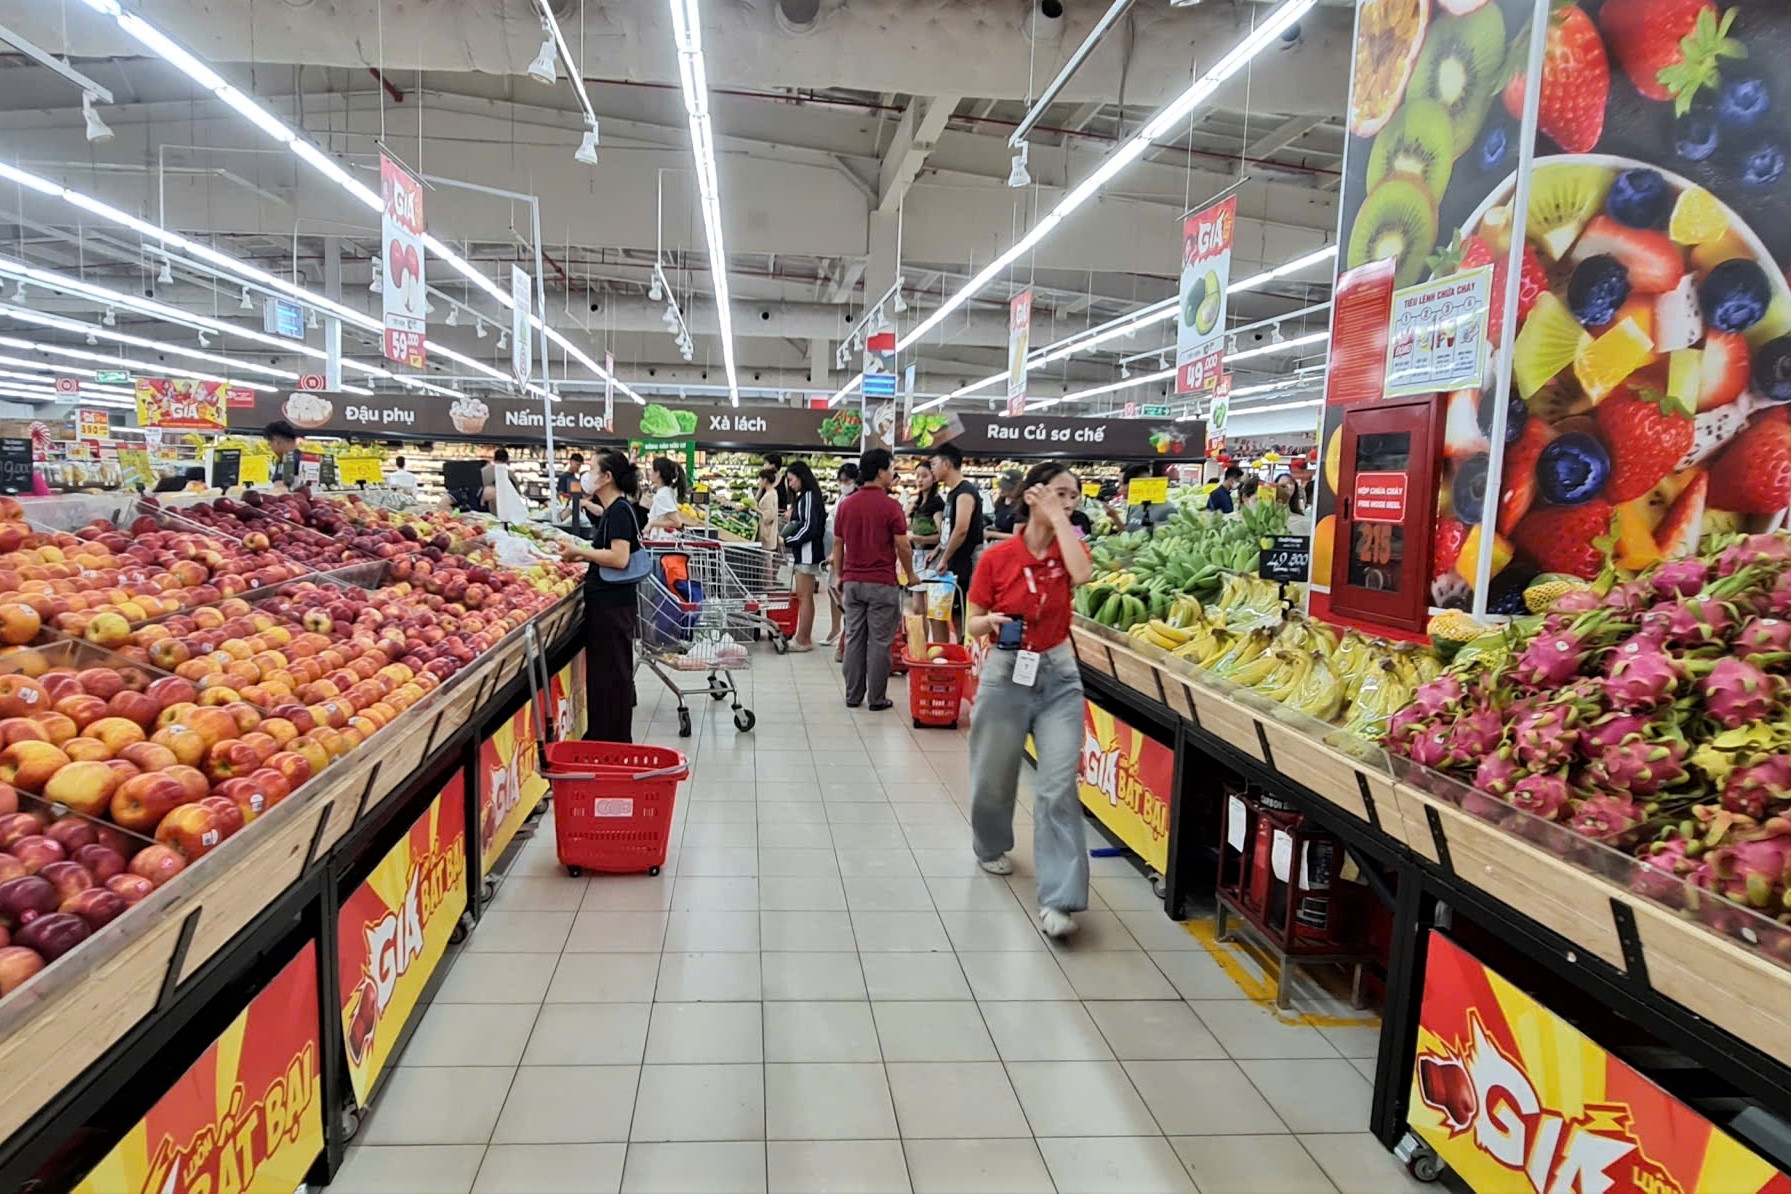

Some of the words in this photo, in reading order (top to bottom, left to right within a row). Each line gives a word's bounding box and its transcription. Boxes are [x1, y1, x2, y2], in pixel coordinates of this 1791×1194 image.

[345, 405, 379, 424] Đậu
[383, 407, 415, 425] phụ
[505, 408, 544, 426] Nấm
[551, 412, 576, 427] các
[709, 414, 731, 431] Xà
[734, 415, 767, 432] lách
[987, 424, 1019, 439] Rau
[1023, 422, 1047, 440] Củ
[1050, 427, 1071, 441] sơ
[1074, 425, 1106, 442] chế
